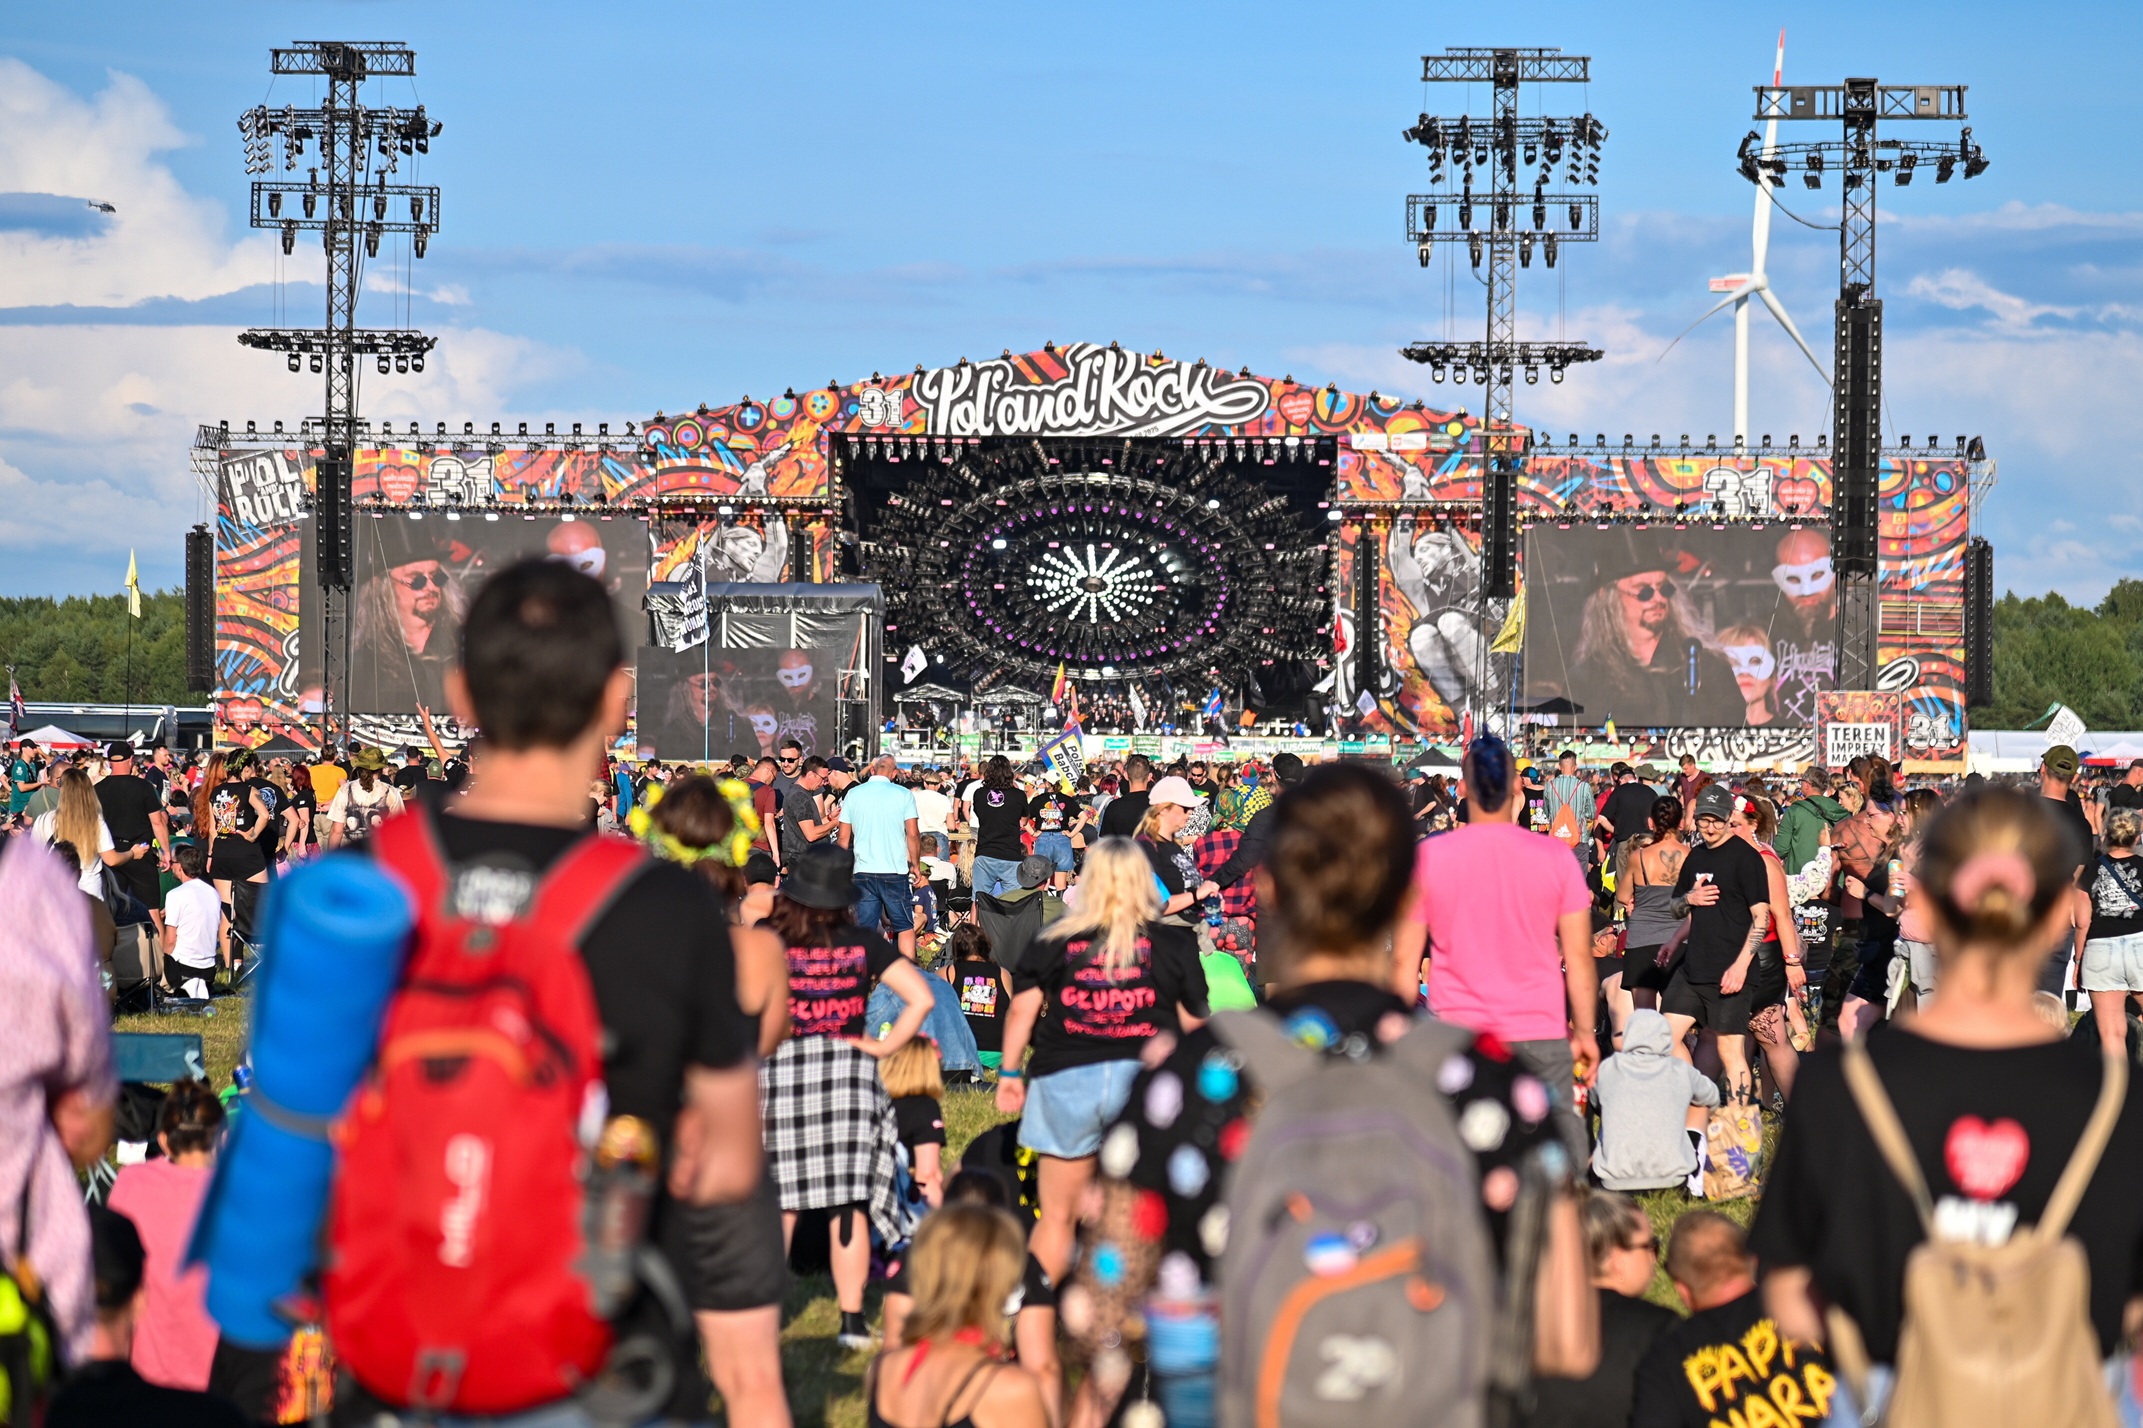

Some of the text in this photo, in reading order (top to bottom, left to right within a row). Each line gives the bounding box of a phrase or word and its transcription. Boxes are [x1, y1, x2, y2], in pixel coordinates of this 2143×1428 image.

[858, 387, 904, 428] 31
[426, 456, 495, 507] 31
[1700, 466, 1773, 516] 31
[234, 483, 303, 526] ROCK
[1831, 727, 1885, 741] TEREN
[1831, 742, 1885, 754] IMPREZY
[1907, 712, 1951, 751] 31
[1831, 753, 1885, 763] MASJ
[972, 984, 992, 998] 31
